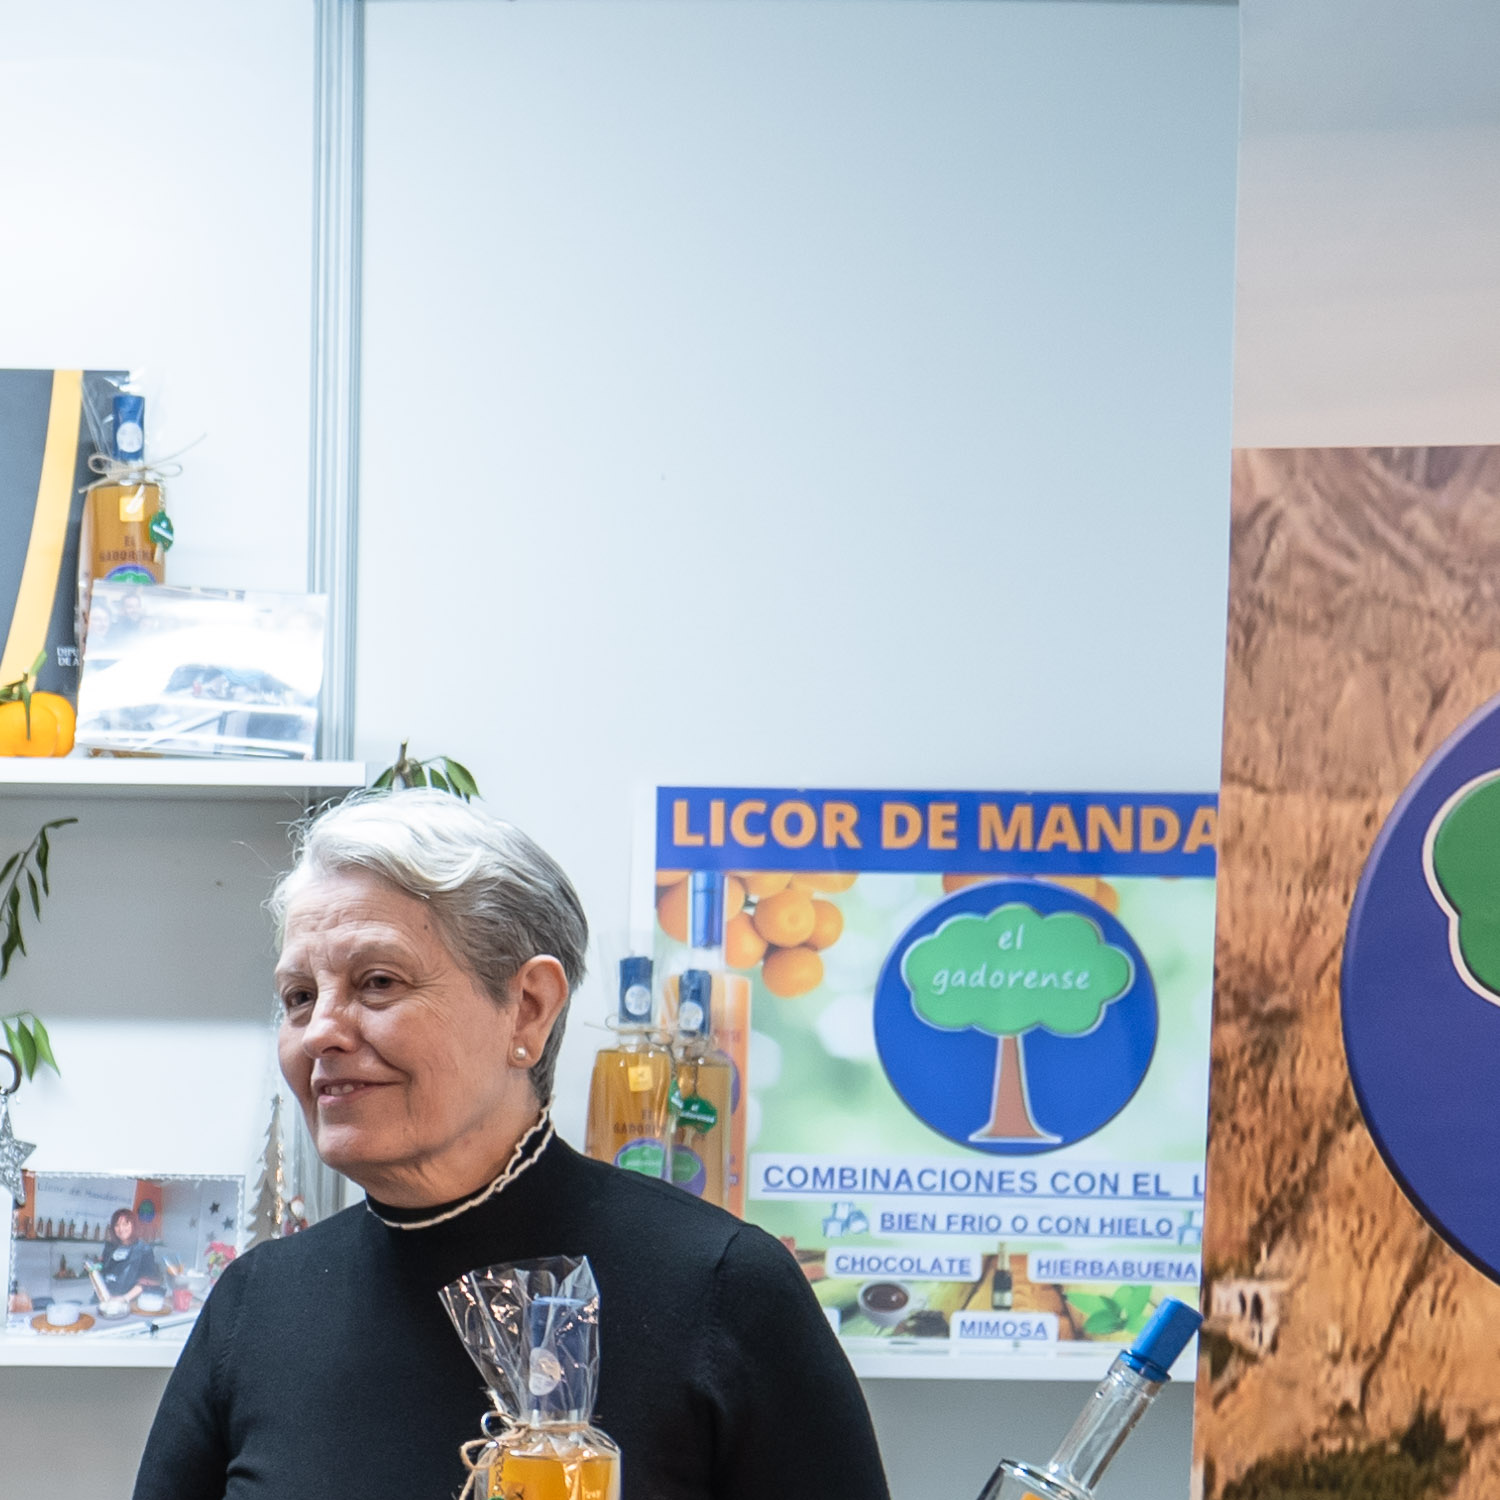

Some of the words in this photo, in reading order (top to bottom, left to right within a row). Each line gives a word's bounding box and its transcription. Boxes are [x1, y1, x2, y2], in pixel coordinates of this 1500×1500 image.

[673, 800, 862, 849] LICOR
[882, 802, 958, 850] DE
[998, 924, 1024, 951] el
[931, 963, 1092, 995] gadorense
[763, 1165, 1038, 1194] COMBINACIONES
[1050, 1171, 1123, 1196] CON
[1133, 1174, 1171, 1197] EL
[880, 1211, 936, 1232] BIEN
[946, 1213, 1001, 1234] FRIO
[1012, 1214, 1029, 1235] O
[1037, 1216, 1090, 1235] CON
[1100, 1218, 1174, 1237] HIELO
[835, 1255, 972, 1276] CHOCOLATE
[1036, 1258, 1198, 1280] HIERBABUENA
[959, 1320, 1049, 1338] MIMOSA
